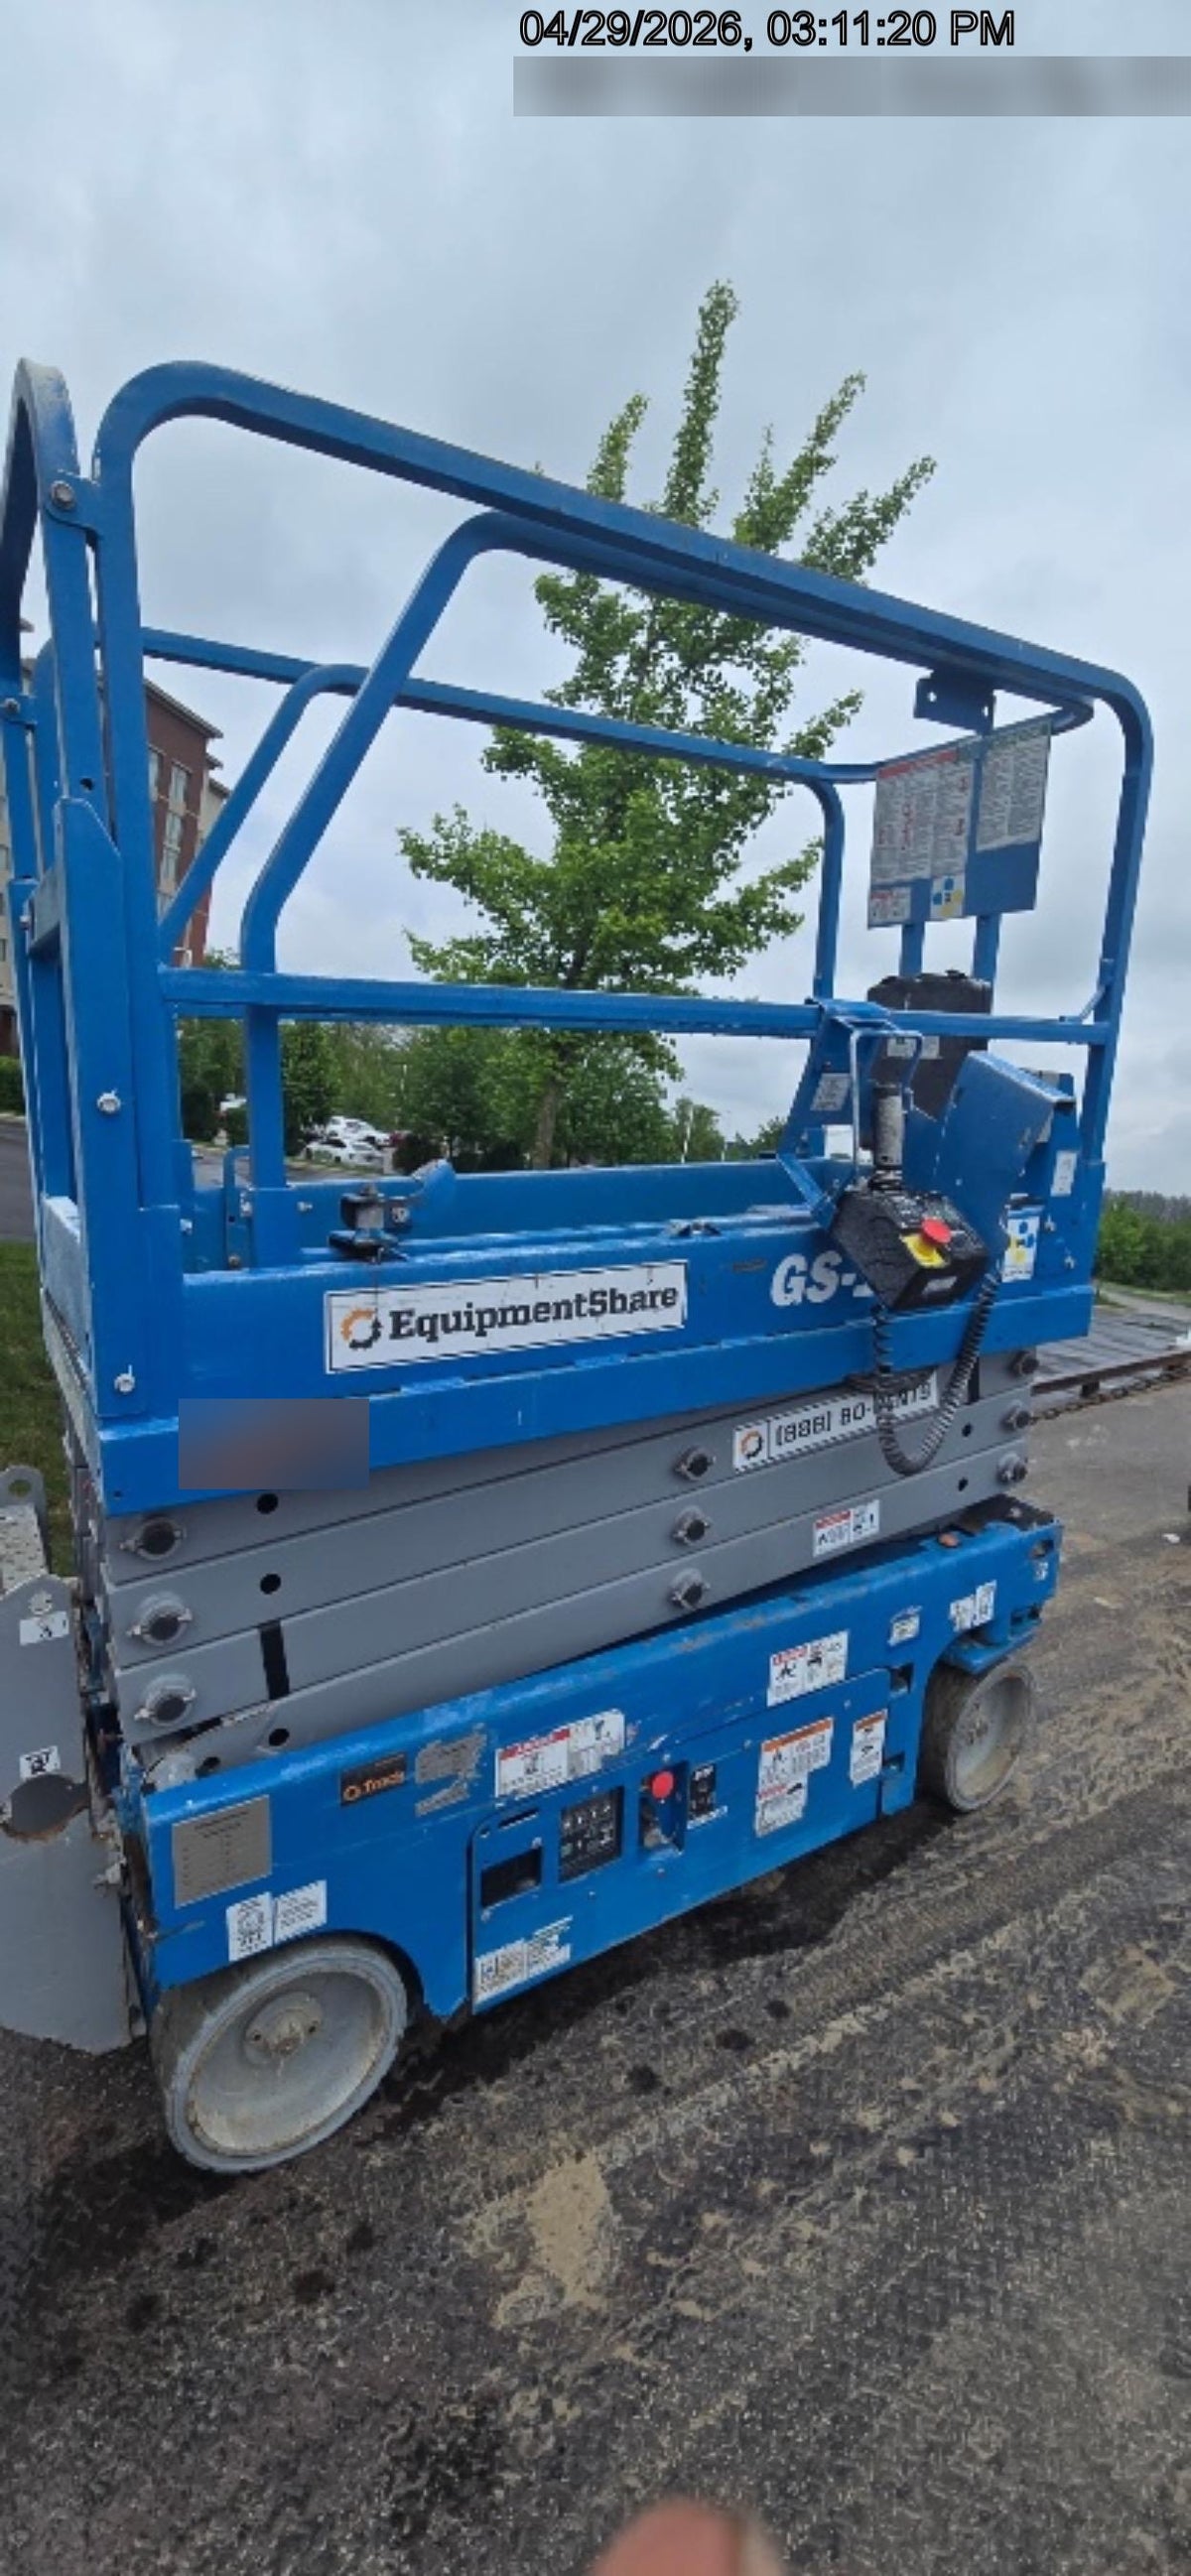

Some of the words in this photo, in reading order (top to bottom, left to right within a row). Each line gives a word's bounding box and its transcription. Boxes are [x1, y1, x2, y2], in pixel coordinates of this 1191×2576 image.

[770, 1250, 875, 1307] GS-
[388, 1286, 679, 1343] EquipmentShare
[775, 1410, 832, 1447] (888)
